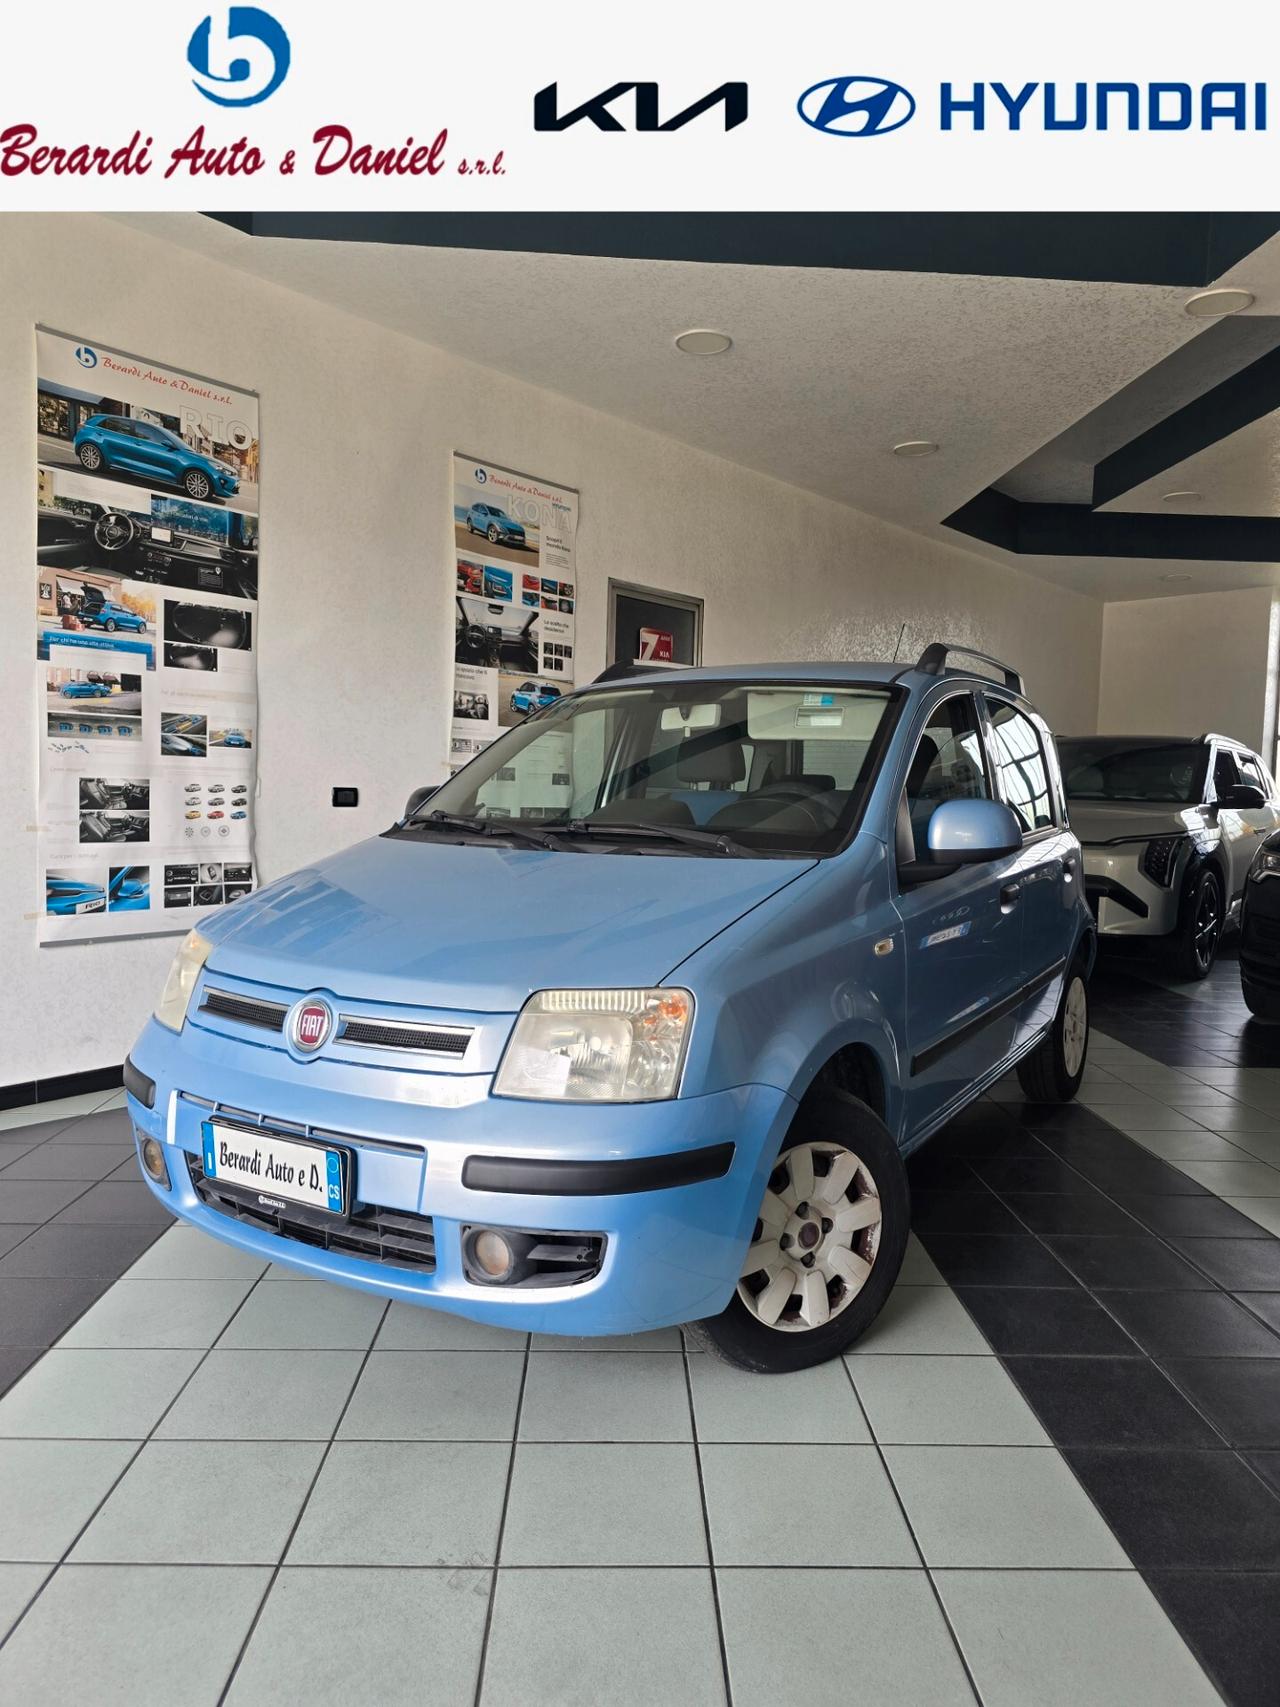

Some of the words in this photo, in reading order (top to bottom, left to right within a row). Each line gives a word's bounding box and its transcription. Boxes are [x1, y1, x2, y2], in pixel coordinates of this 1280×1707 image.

[101, 357, 141, 377] Berardi
[141, 370, 168, 385] Auto
[170, 380, 178, 388] &
[178, 379, 211, 399] Daniel
[179, 405, 253, 450] RIO
[641, 631, 660, 660] 7
[301, 1015, 323, 1037] FIAT
[219, 1141, 262, 1176] Berardi
[265, 1150, 294, 1183] Auto
[299, 1167, 305, 1186] e
[309, 1163, 323, 1192] D.
[328, 1184, 340, 1200] CS
